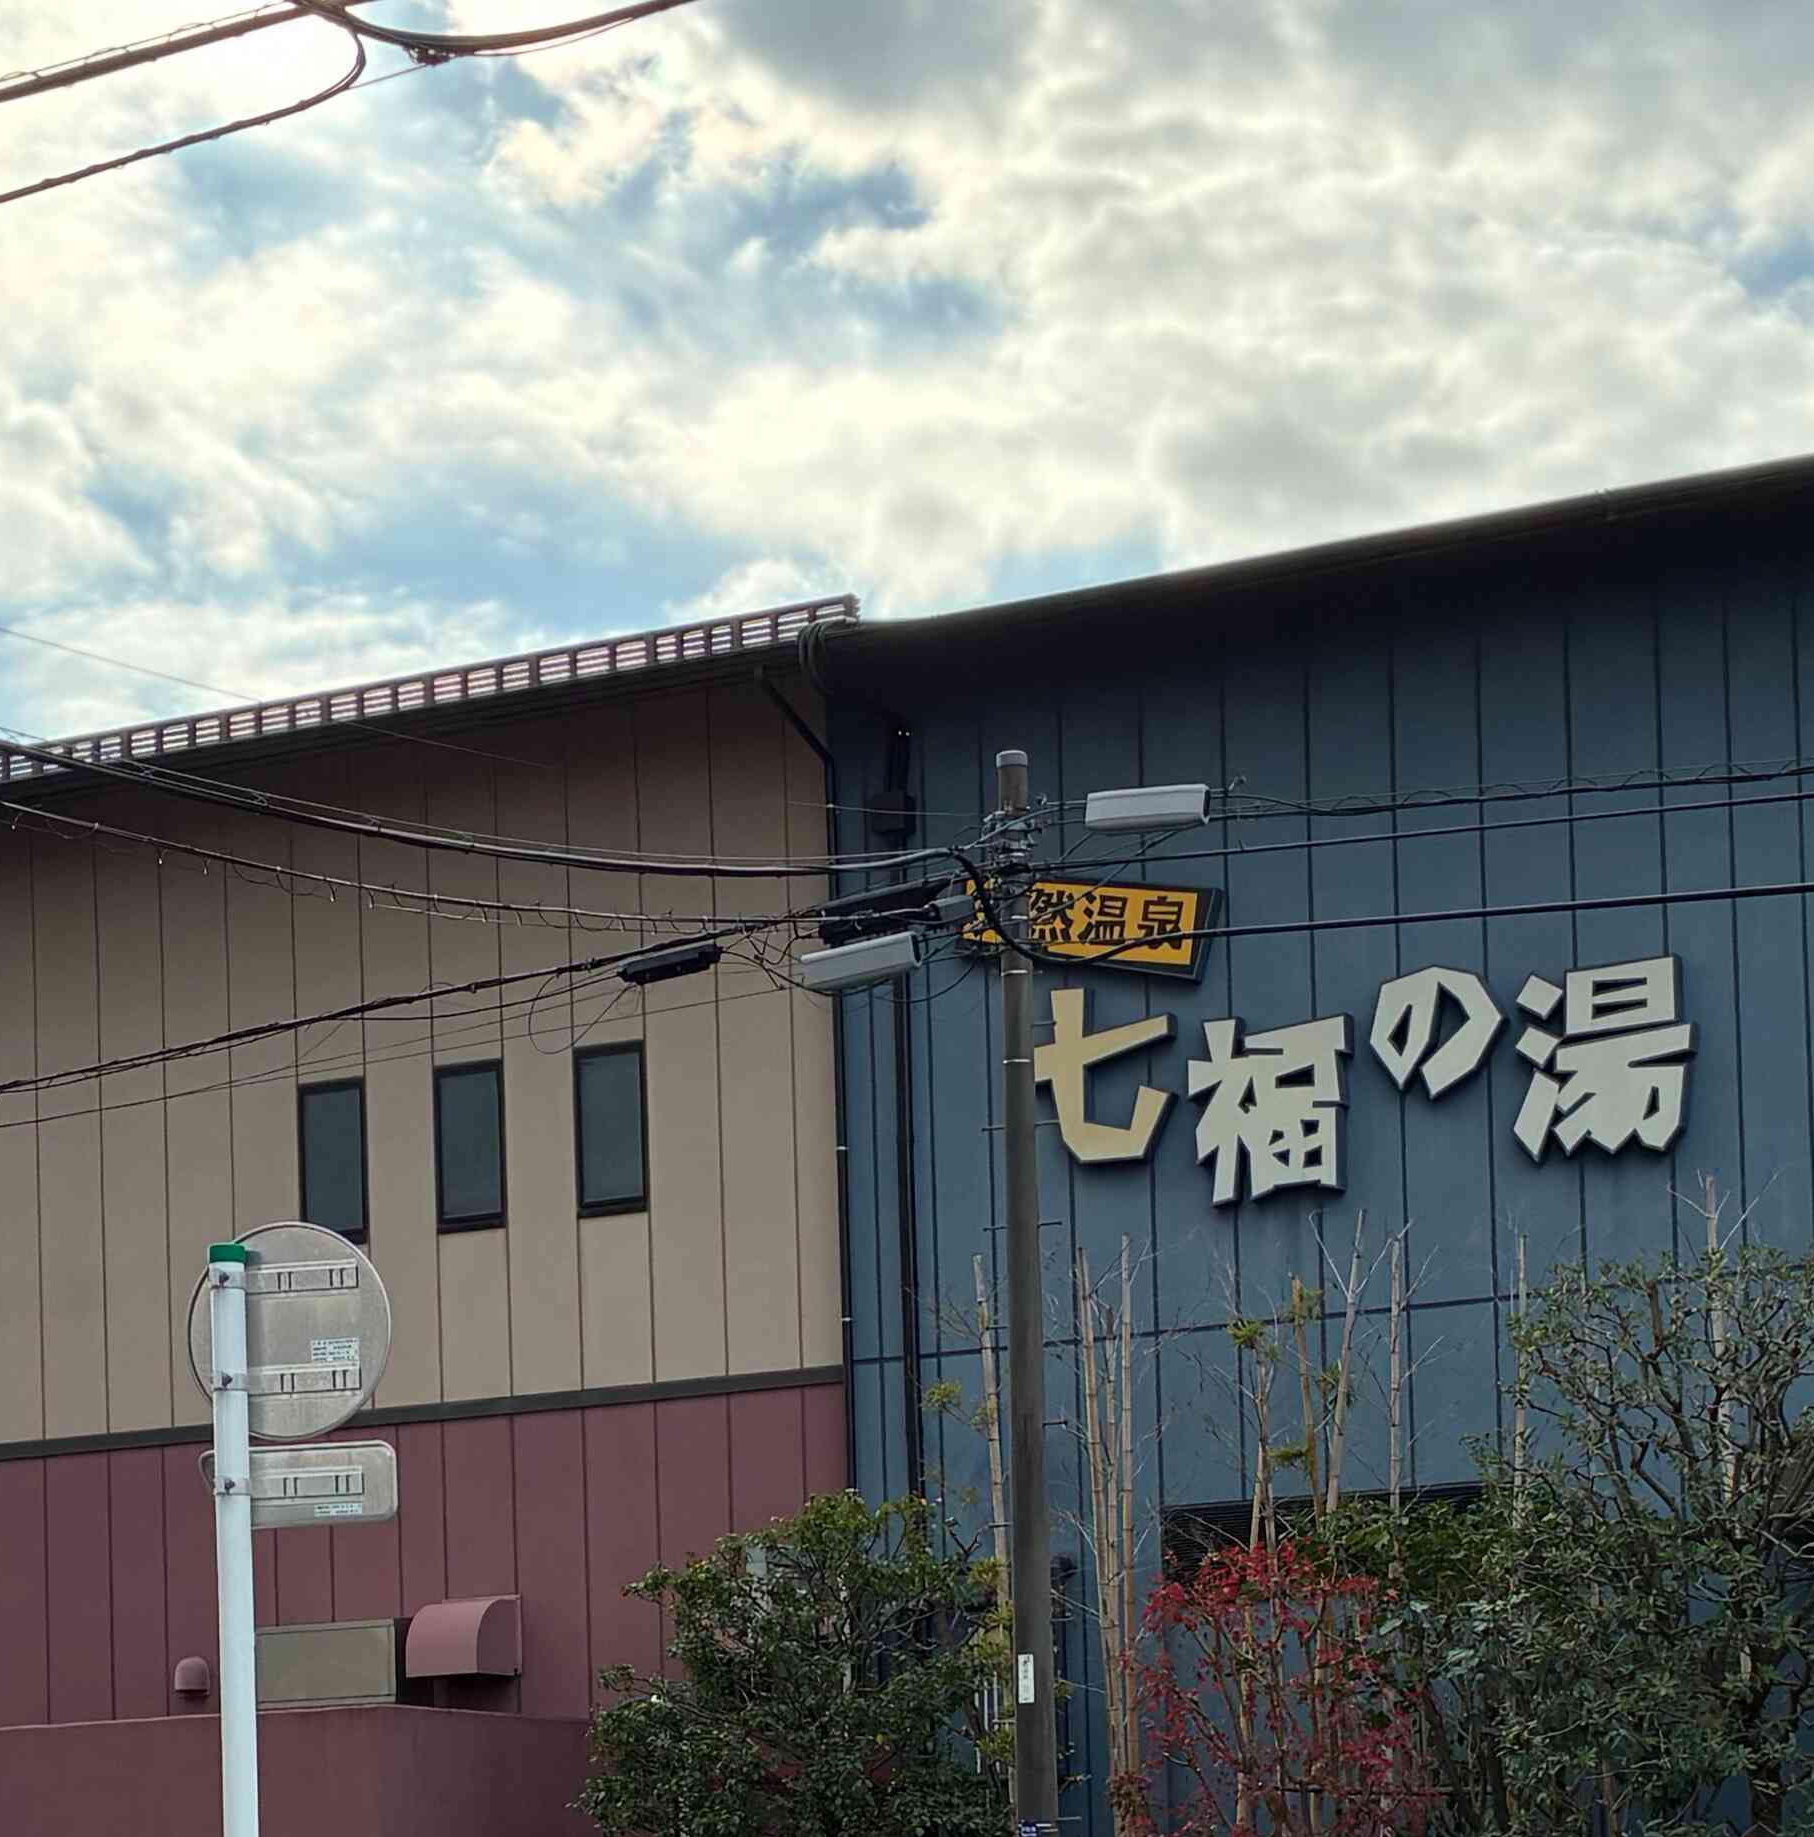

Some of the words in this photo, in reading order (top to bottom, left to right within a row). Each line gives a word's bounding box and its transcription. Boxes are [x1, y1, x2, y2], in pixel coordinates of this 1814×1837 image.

[970, 880, 1184, 950] 然温泉
[1034, 955, 1698, 1206] 七福の湯
